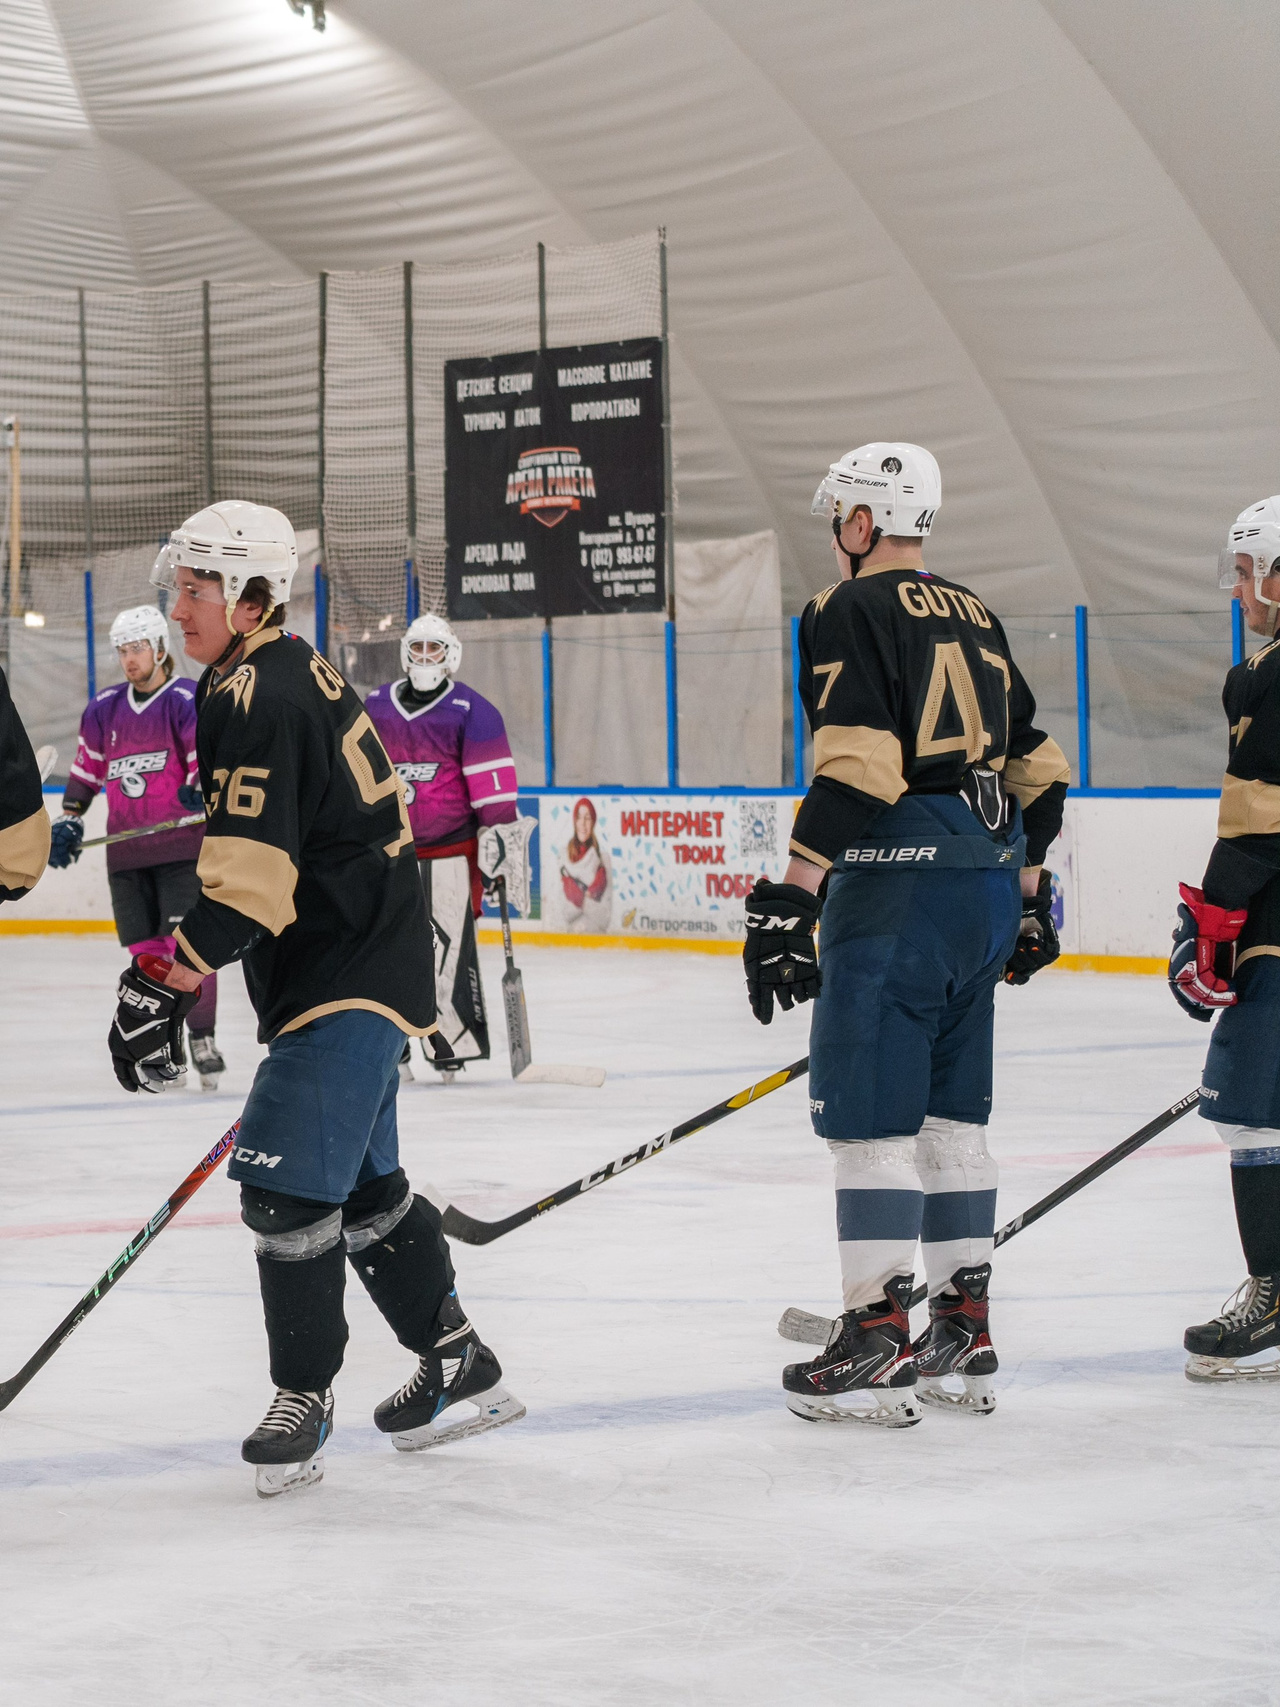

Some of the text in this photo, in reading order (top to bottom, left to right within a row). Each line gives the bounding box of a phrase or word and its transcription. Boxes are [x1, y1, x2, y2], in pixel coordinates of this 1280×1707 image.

[547, 465, 596, 498] РАКЕТА
[854, 478, 888, 488] BAUER
[914, 509, 936, 533] 44
[897, 581, 993, 630] GUTID
[813, 661, 843, 711] 7
[342, 711, 414, 858] 9
[491, 771, 501, 791] 1
[621, 811, 724, 838] ИНТЕРНЕТ
[673, 844, 726, 865] ТВОИХ
[844, 846, 937, 862] BAUER
[640, 915, 718, 933] Петросвязь
[745, 911, 801, 931] CM
[118, 983, 162, 1016] UER
[580, 1128, 674, 1192] CCM
[83, 1199, 171, 1301] TRUE
[964, 1270, 989, 1281] CCM
[917, 1348, 937, 1366] CCM
[833, 1362, 852, 1376] CM
